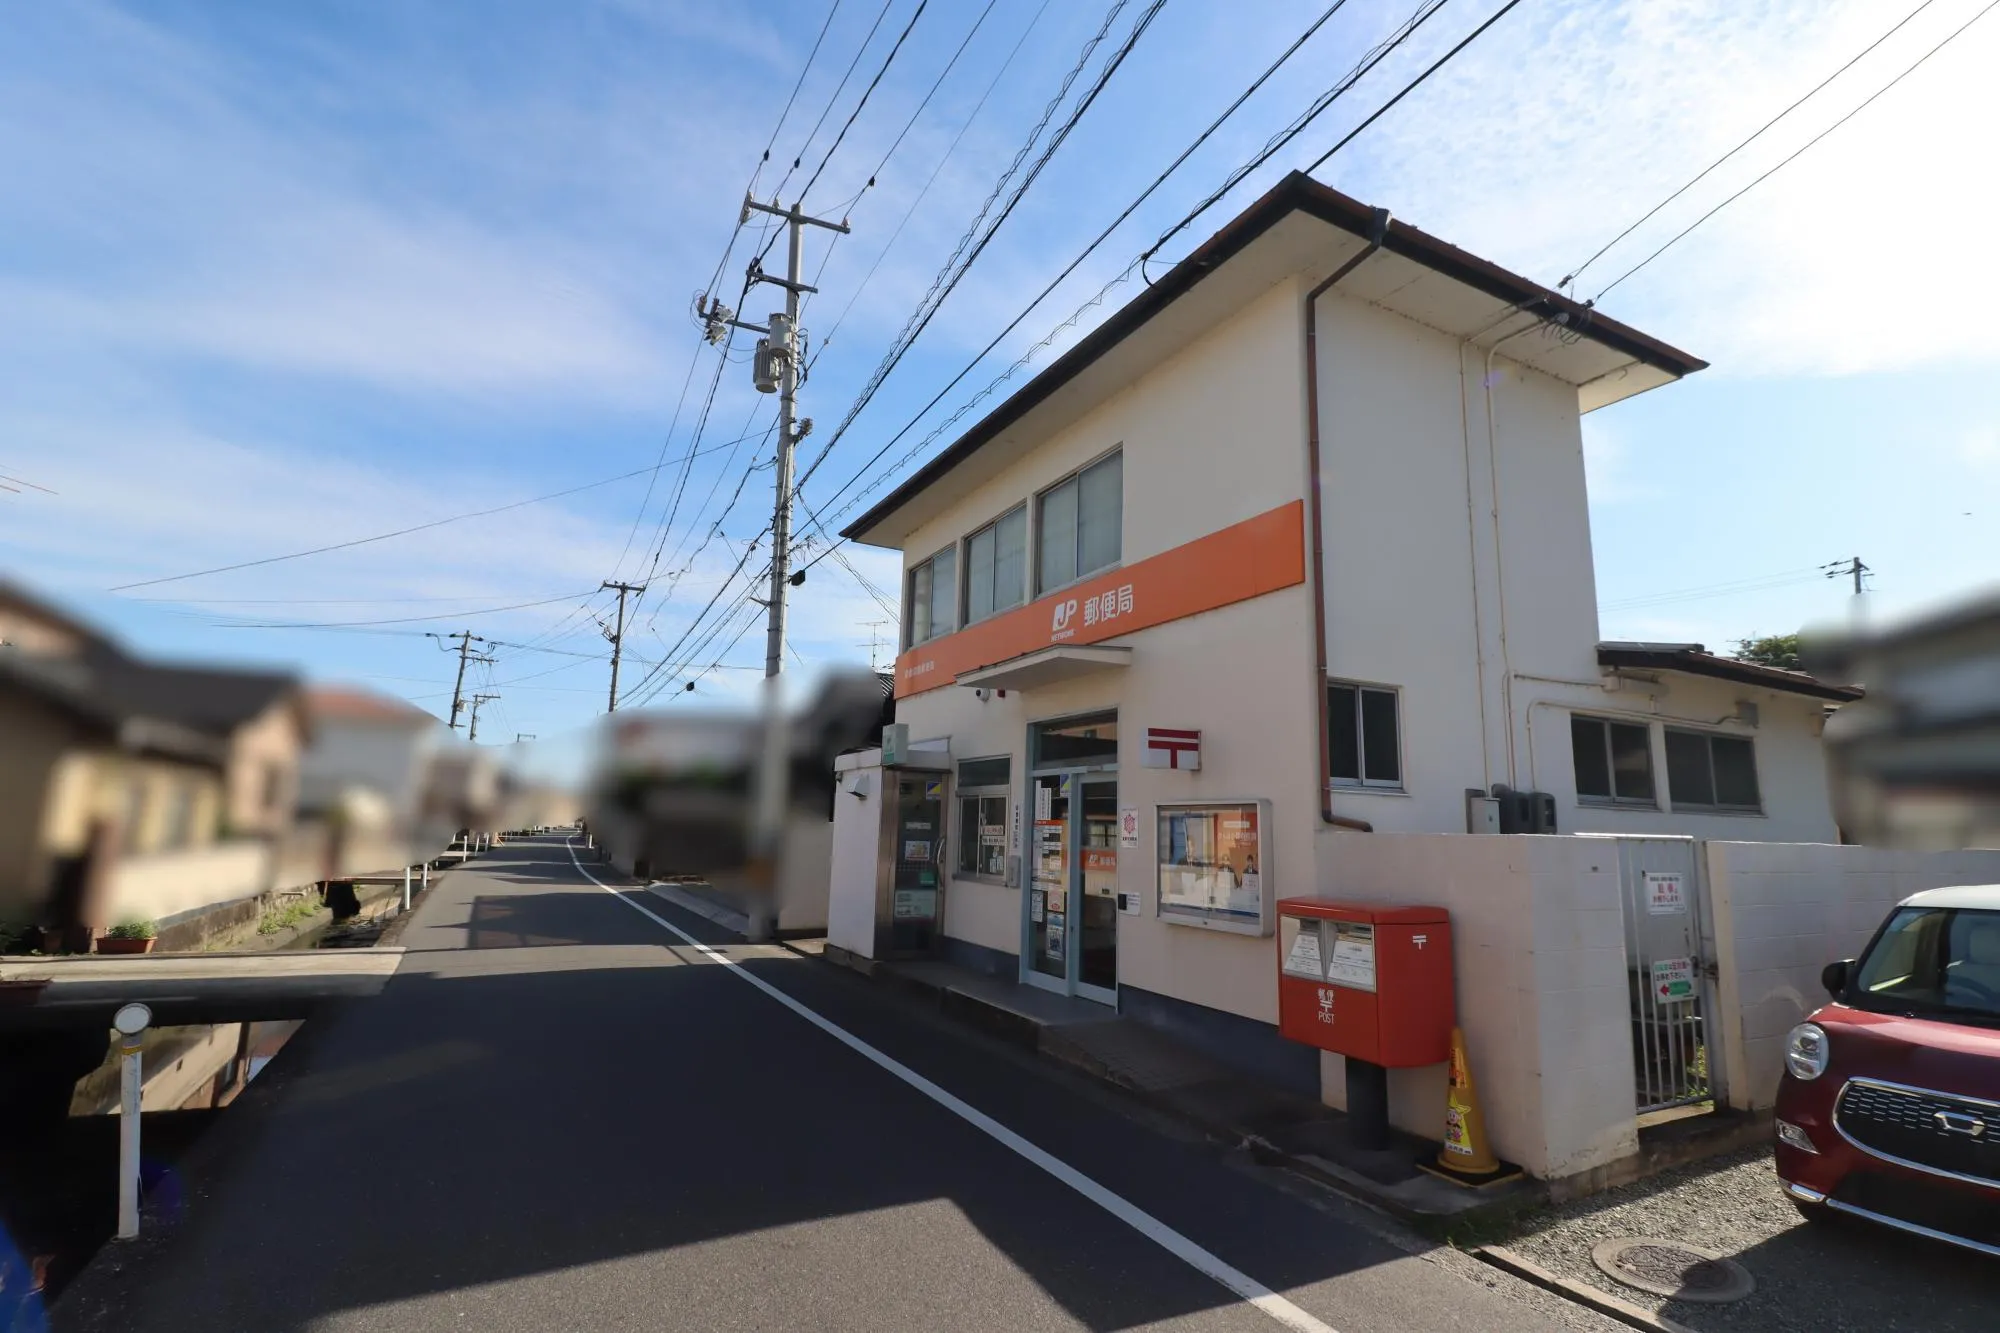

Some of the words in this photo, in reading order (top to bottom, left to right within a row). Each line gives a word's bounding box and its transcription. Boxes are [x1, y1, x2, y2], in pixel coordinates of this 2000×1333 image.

[1084, 584, 1134, 627] 郵便局
[1318, 988, 1334, 1002] 郵便
[1318, 1010, 1335, 1025] POST
